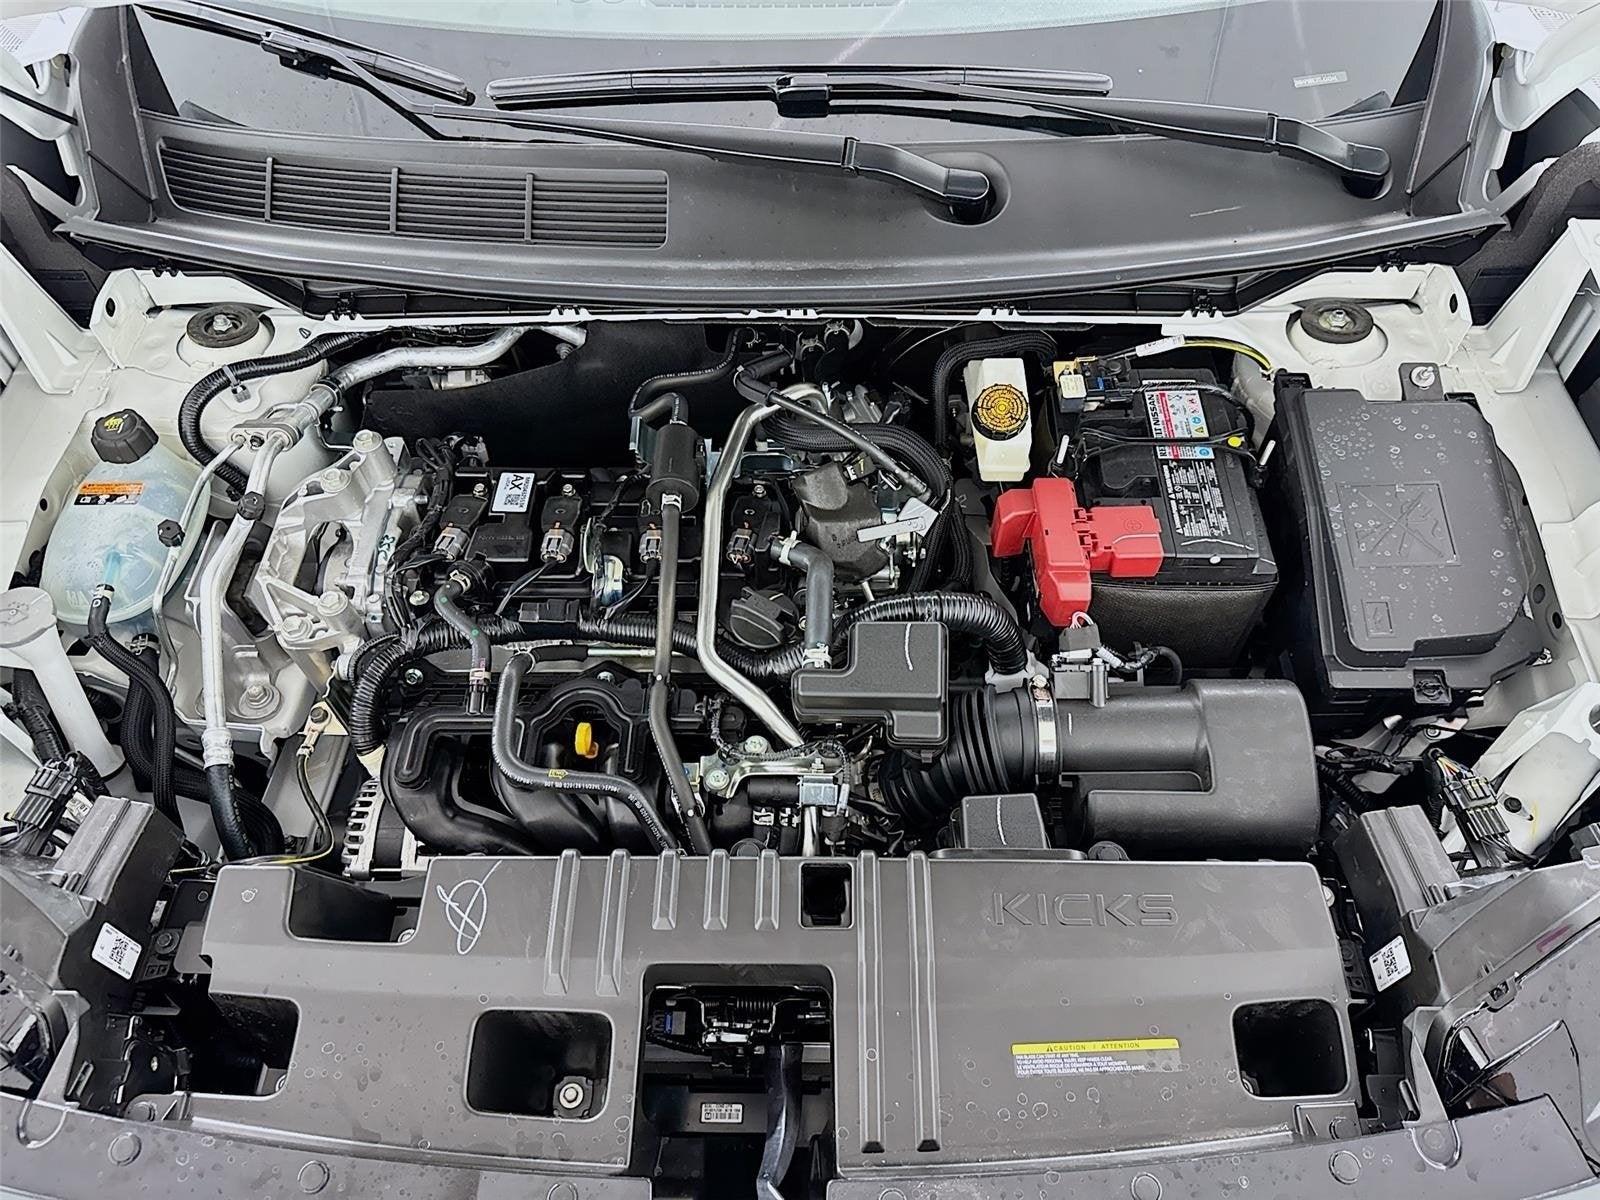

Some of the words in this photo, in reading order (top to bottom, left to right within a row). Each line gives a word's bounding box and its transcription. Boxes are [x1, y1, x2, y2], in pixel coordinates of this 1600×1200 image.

[1147, 394, 1161, 426] NISSAN
[509, 474, 524, 490] AX
[993, 892, 1179, 927] KICKS
[1053, 1043, 1086, 1051] CAUTION
[1101, 1041, 1140, 1049] ATTENTION
